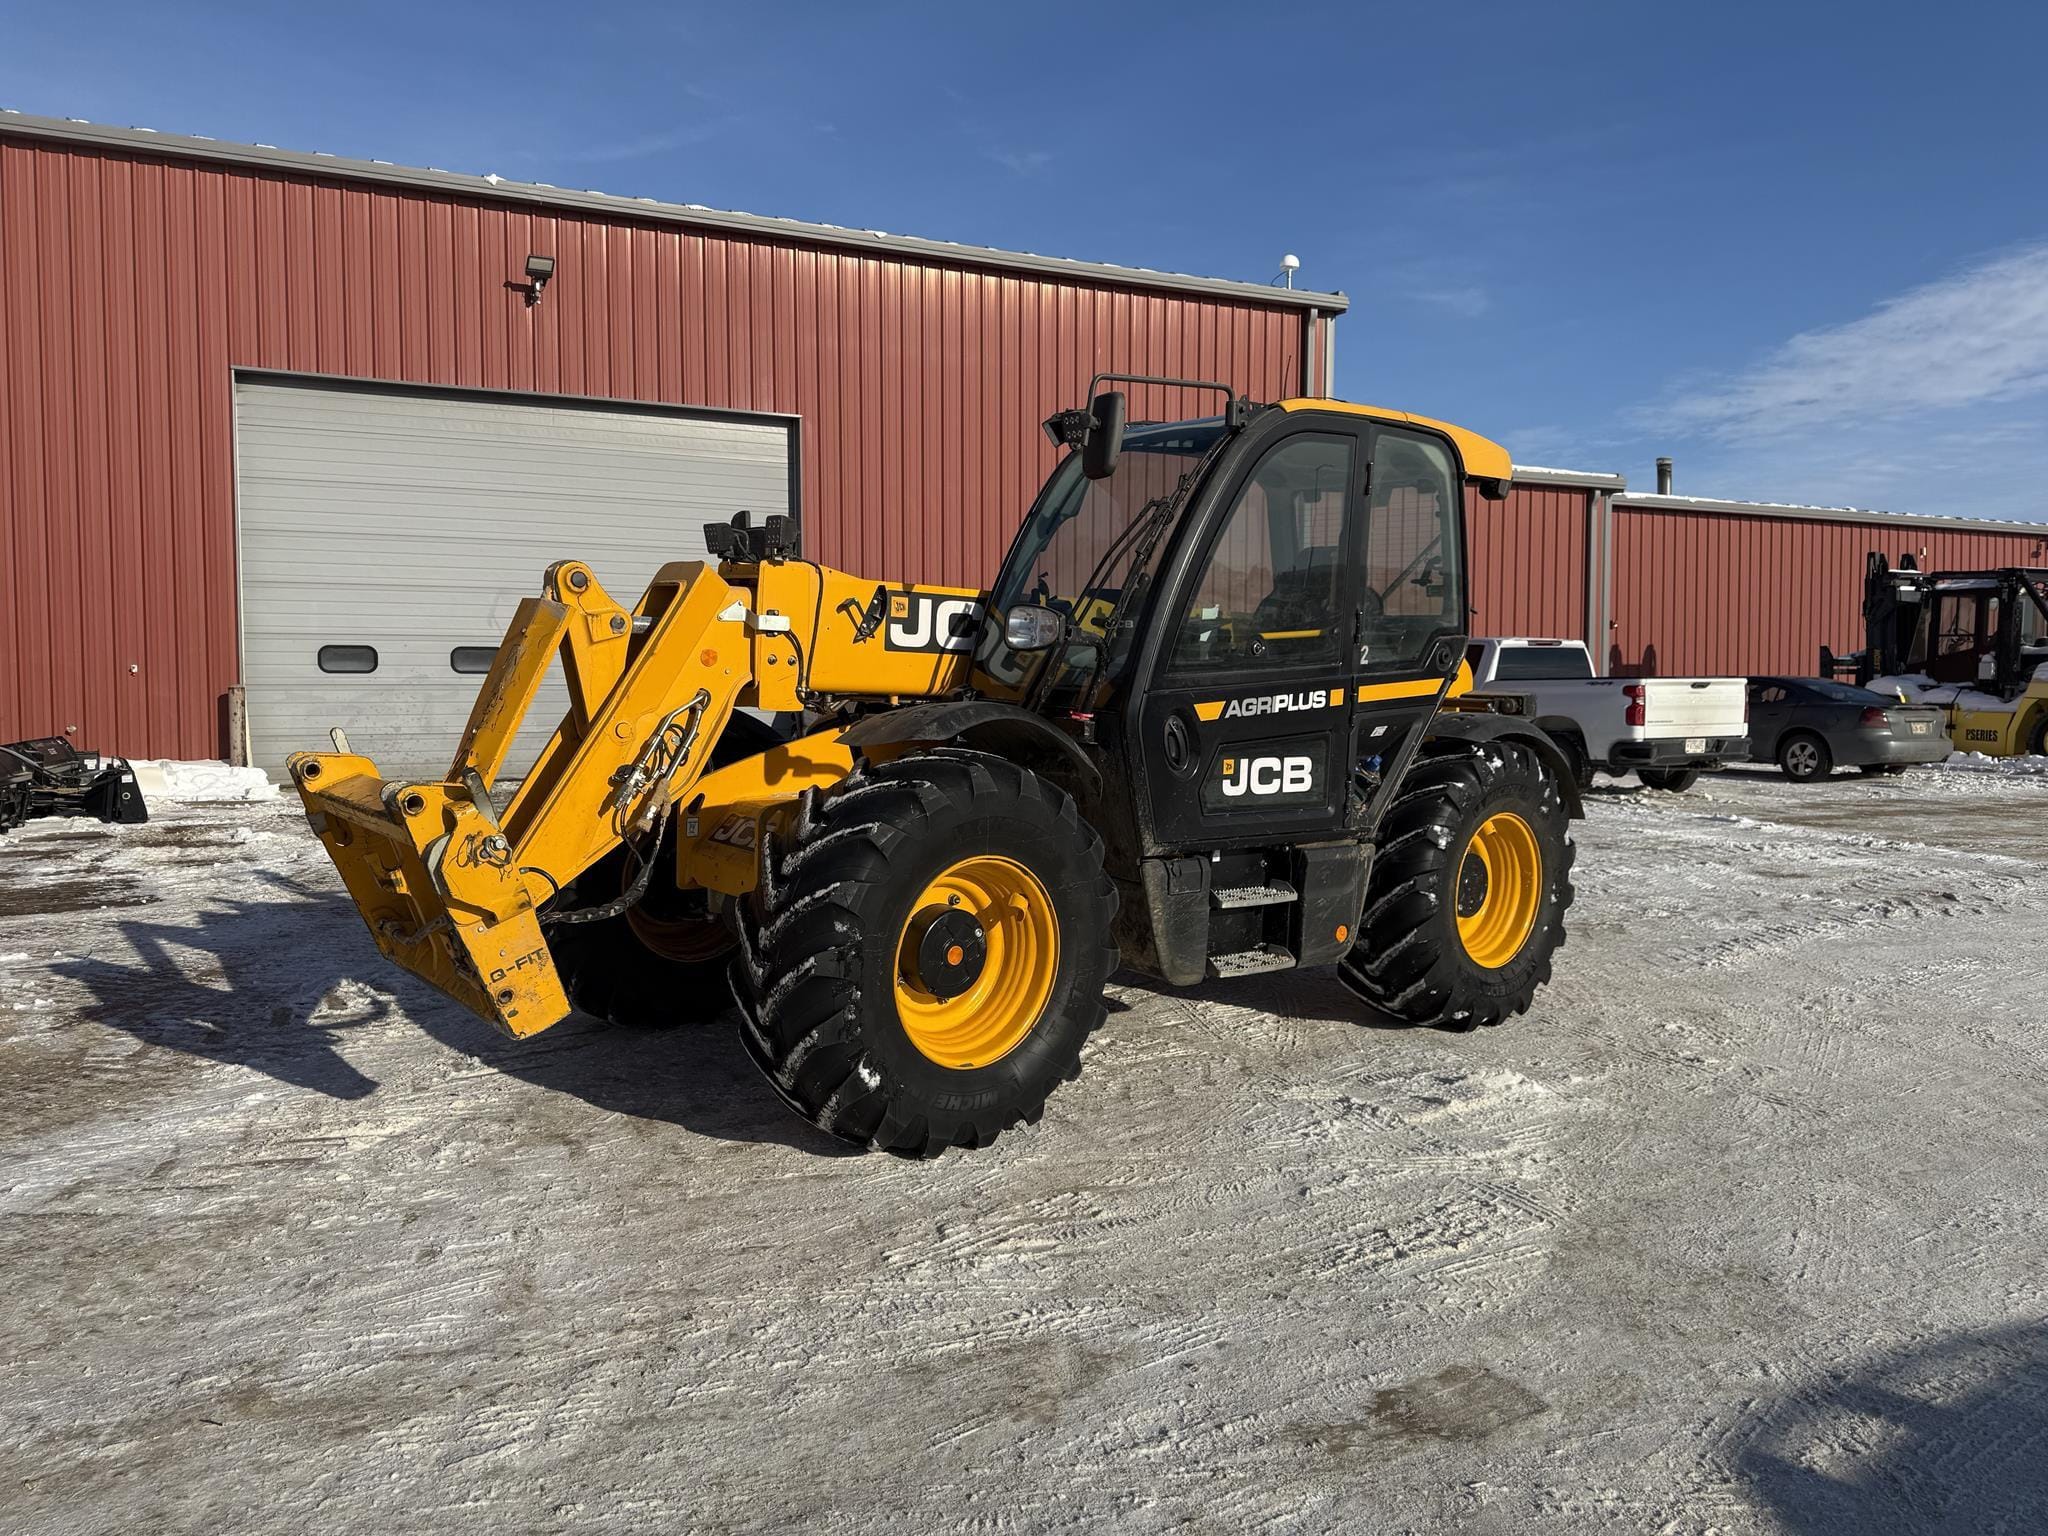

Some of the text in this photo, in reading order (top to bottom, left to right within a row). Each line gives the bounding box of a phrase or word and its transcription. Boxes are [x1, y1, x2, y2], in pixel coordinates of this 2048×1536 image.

[890, 599, 980, 649] JC
[1360, 645, 1369, 665] 2
[1225, 690, 1326, 718] AGRIPLUS
[1222, 757, 1312, 796] JCB
[713, 818, 755, 849] JC
[490, 947, 543, 983] Q-FIT
[918, 1089, 999, 1110] MICHE
